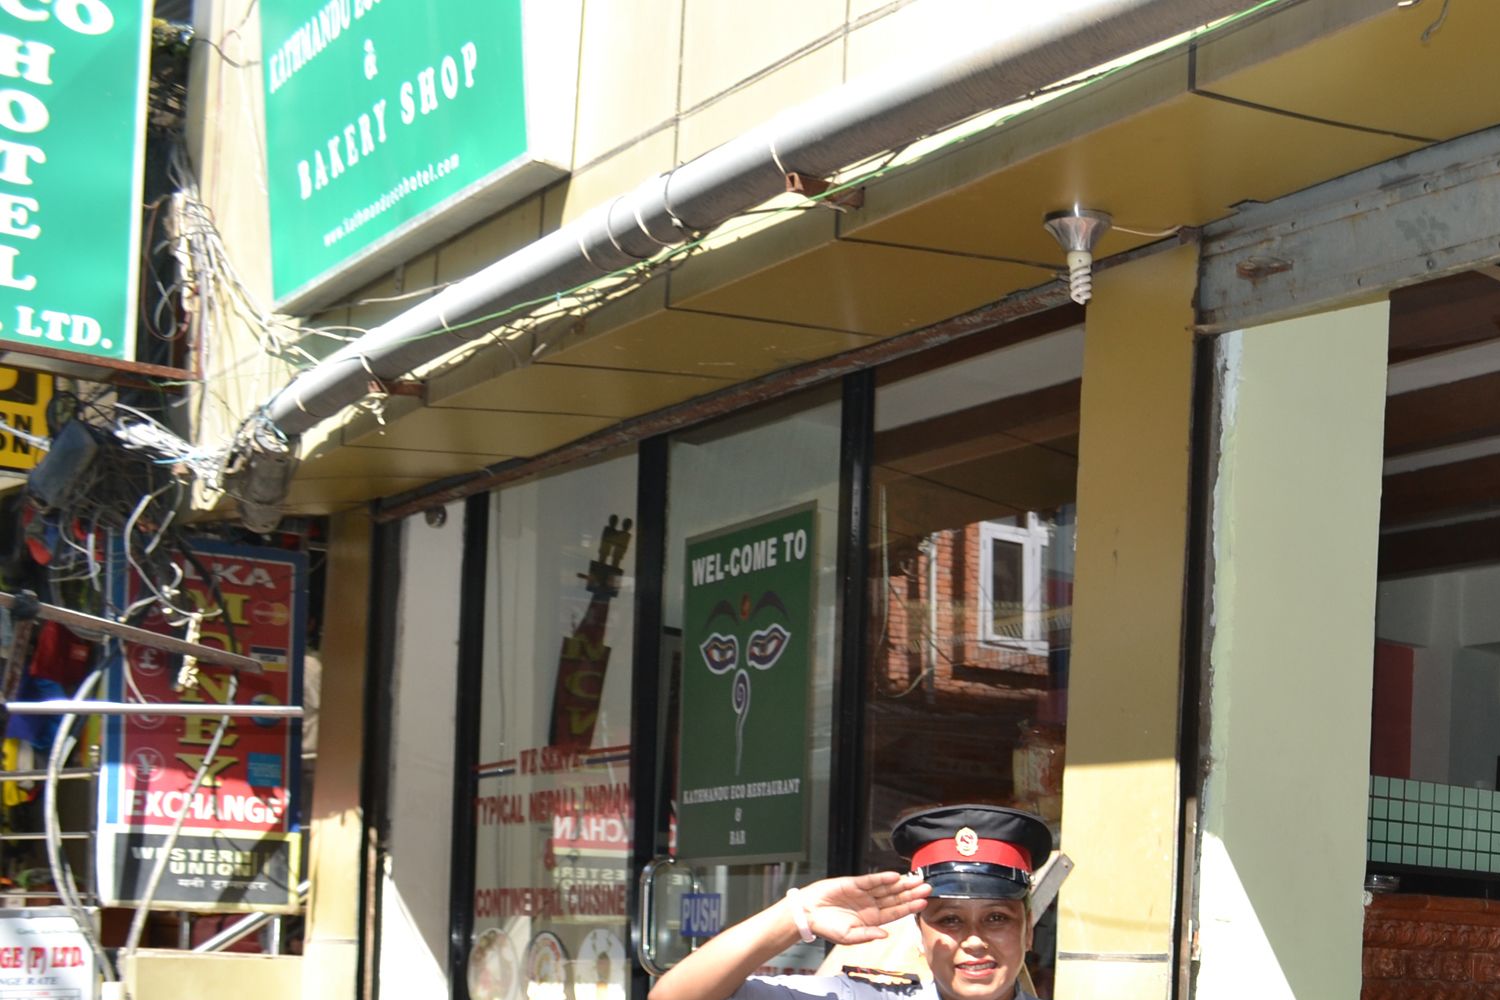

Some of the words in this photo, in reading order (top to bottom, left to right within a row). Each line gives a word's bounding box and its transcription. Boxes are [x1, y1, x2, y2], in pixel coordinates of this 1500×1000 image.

[363, 38, 378, 81] &
[297, 98, 387, 201] BAKERY
[400, 41, 477, 125] SHOP
[14, 304, 114, 350] LTD.
[691, 537, 778, 588] WEL-COME
[782, 529, 807, 563] TO
[124, 789, 283, 824] EXCHANGE
[728, 830, 746, 846] BAR
[169, 861, 252, 877] UNION
[682, 896, 720, 934] PUSH
[50, 946, 85, 969] LTD.
